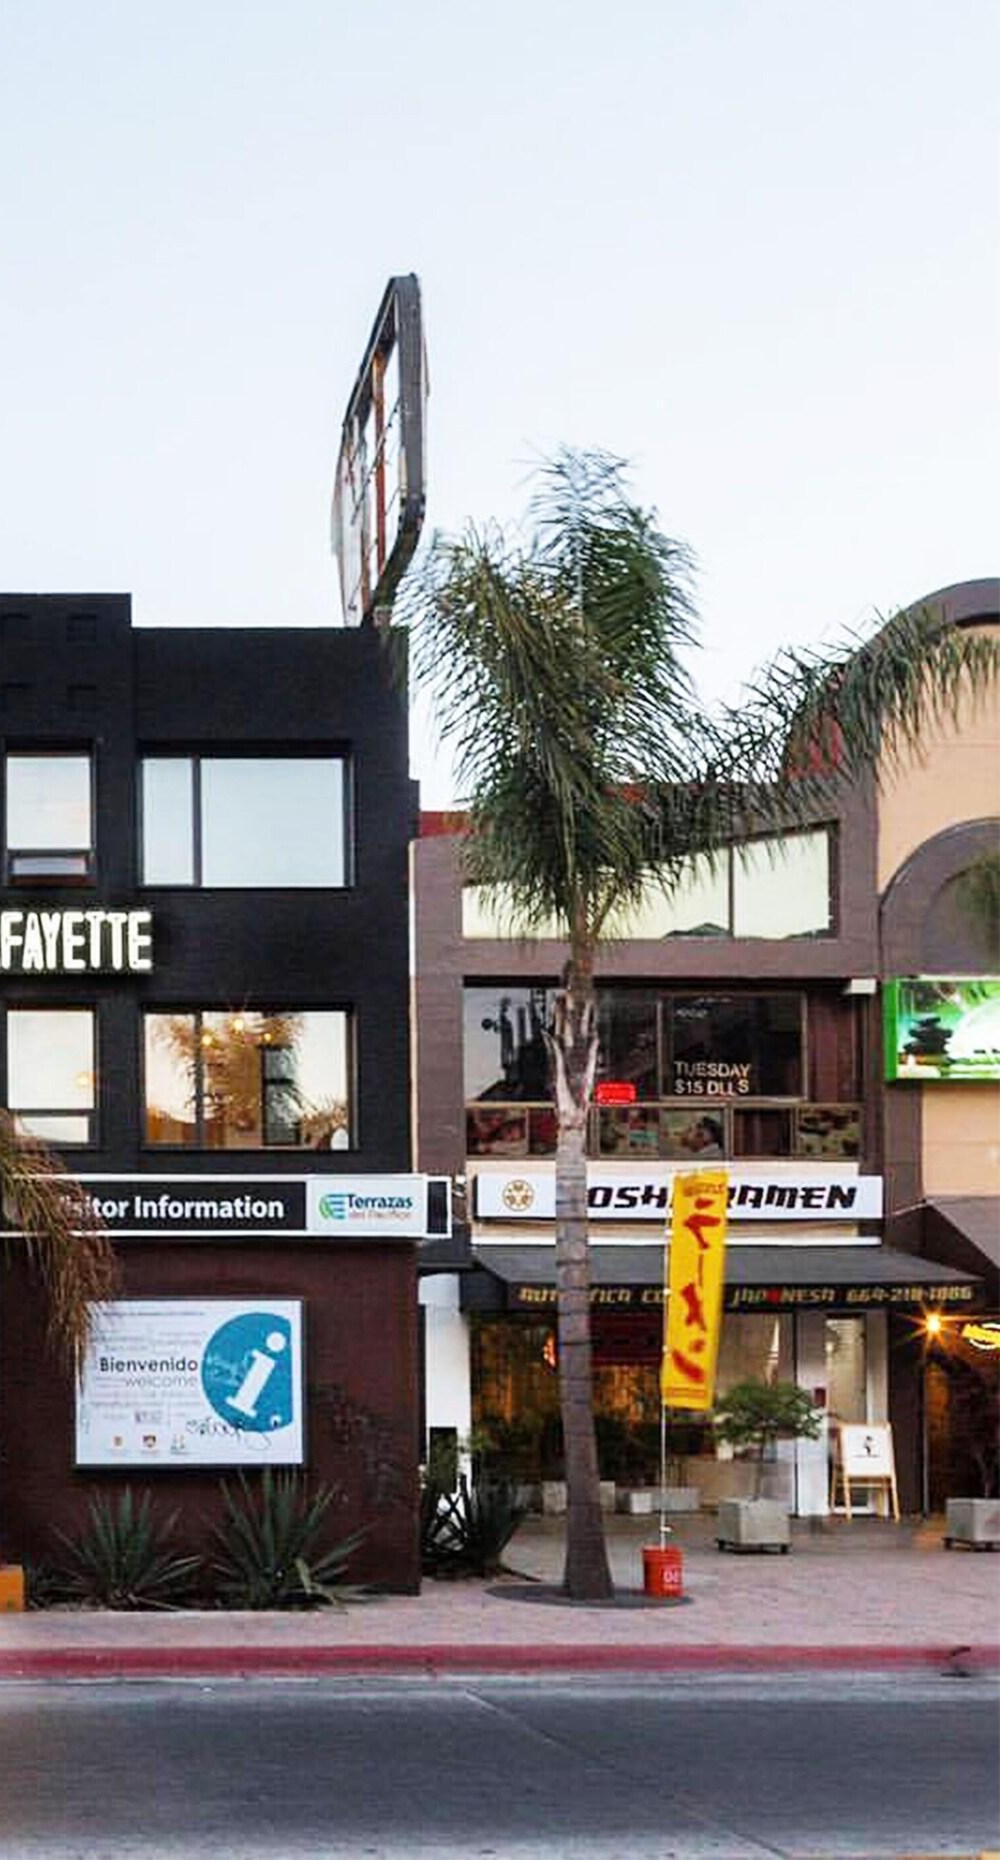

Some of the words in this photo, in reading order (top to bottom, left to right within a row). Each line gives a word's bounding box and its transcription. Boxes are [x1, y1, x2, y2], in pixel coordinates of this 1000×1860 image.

[674, 1061, 751, 1077] TUESDAY
[134, 1195, 285, 1219] Information
[347, 1194, 413, 1210] Terrazas
[99, 1352, 199, 1372] Bienvenido
[125, 1374, 199, 1389] welcome
